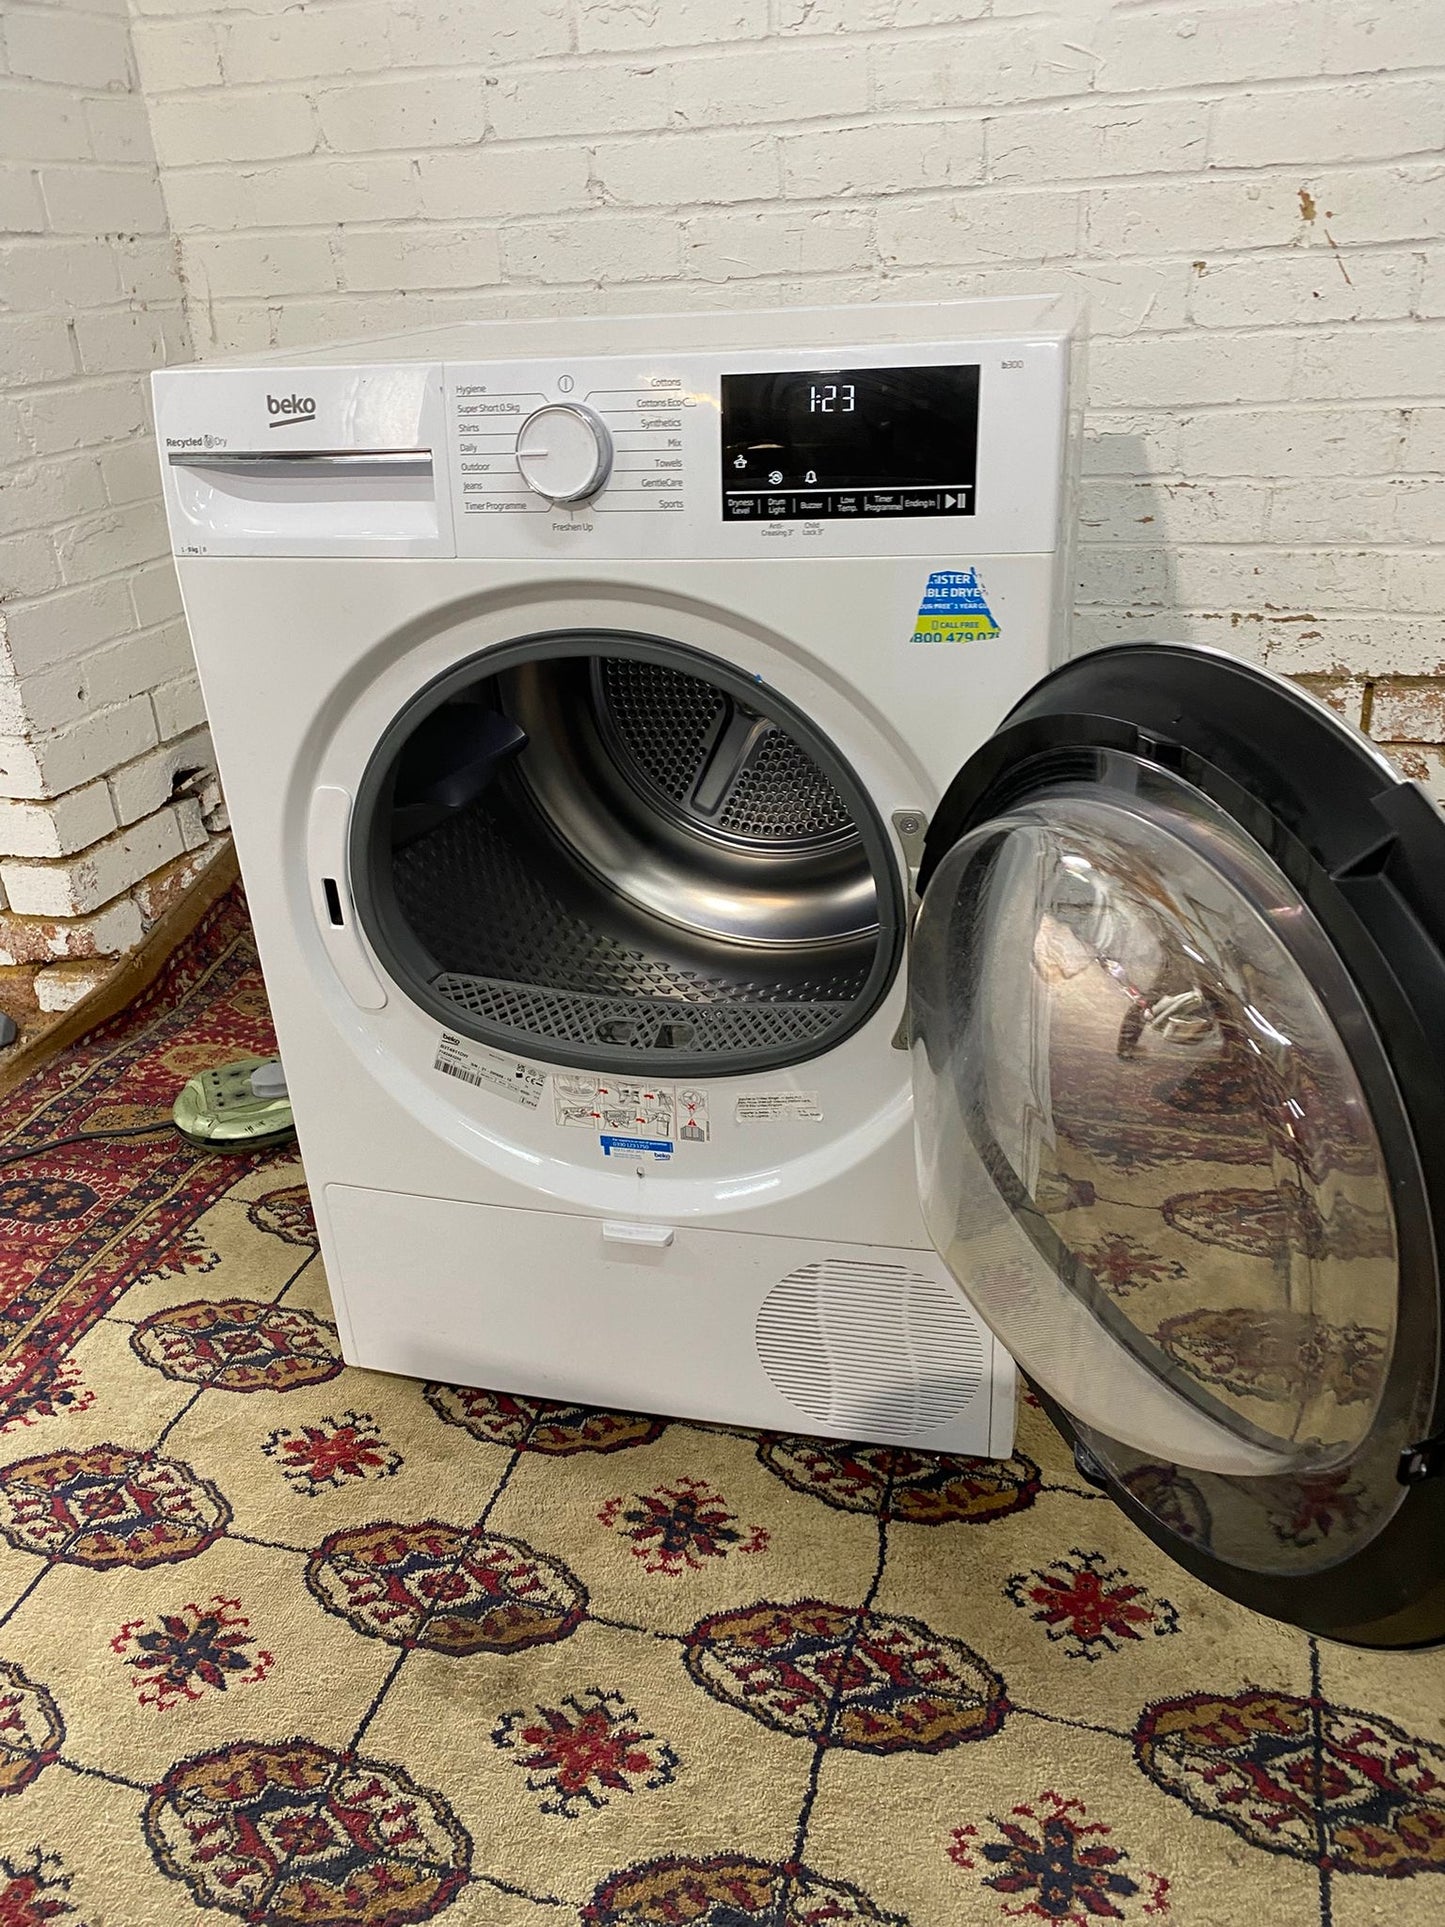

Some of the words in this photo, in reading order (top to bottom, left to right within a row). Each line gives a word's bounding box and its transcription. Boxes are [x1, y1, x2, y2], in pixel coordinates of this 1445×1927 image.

[651, 378, 682, 388] Cottons
[456, 384, 487, 395] Hygiene
[637, 399, 666, 408] Cottons
[667, 398, 682, 408] Eco
[810, 385, 855, 413] 1:23
[266, 394, 316, 415] beko
[457, 404, 479, 414] Super
[479, 404, 499, 412] Short
[500, 403, 520, 414] 0.5kg
[459, 424, 479, 433] Shirts
[641, 418, 682, 429] Synthetics
[166, 437, 202, 448] Recycled
[668, 439, 682, 448] Mix
[460, 443, 478, 454] Daily
[461, 462, 490, 472] Outdoor
[655, 459, 683, 468] Towels
[463, 481, 483, 491] Jeans
[641, 478, 683, 488] GentleCare
[465, 502, 487, 511] Timer
[488, 501, 527, 512] Programme
[659, 500, 684, 510] Sports
[728, 499, 754, 508] Dryness
[905, 499, 928, 509] Ending
[732, 507, 750, 515] Level
[768, 506, 786, 515] Light
[552, 523, 581, 532] Freshen
[582, 523, 593, 534] Up
